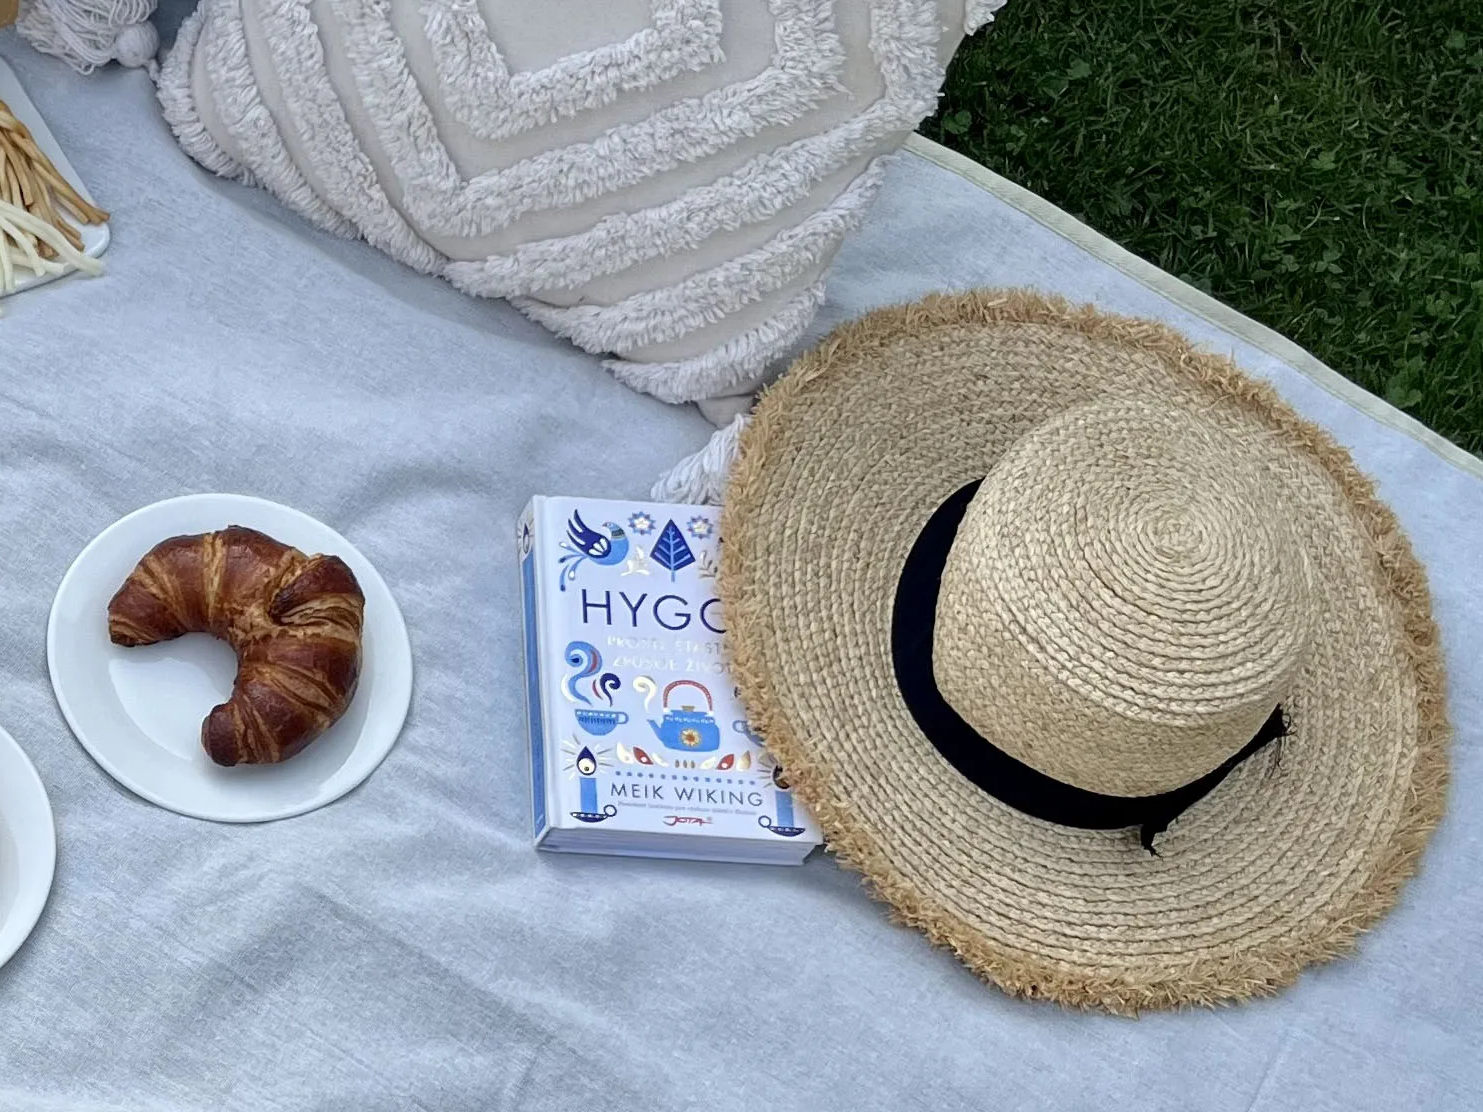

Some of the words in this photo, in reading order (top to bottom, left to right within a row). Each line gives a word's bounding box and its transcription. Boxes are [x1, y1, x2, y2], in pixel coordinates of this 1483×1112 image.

[582, 587, 728, 634] HYGG
[610, 782, 664, 800] MEIK
[674, 786, 763, 807] WIKING
